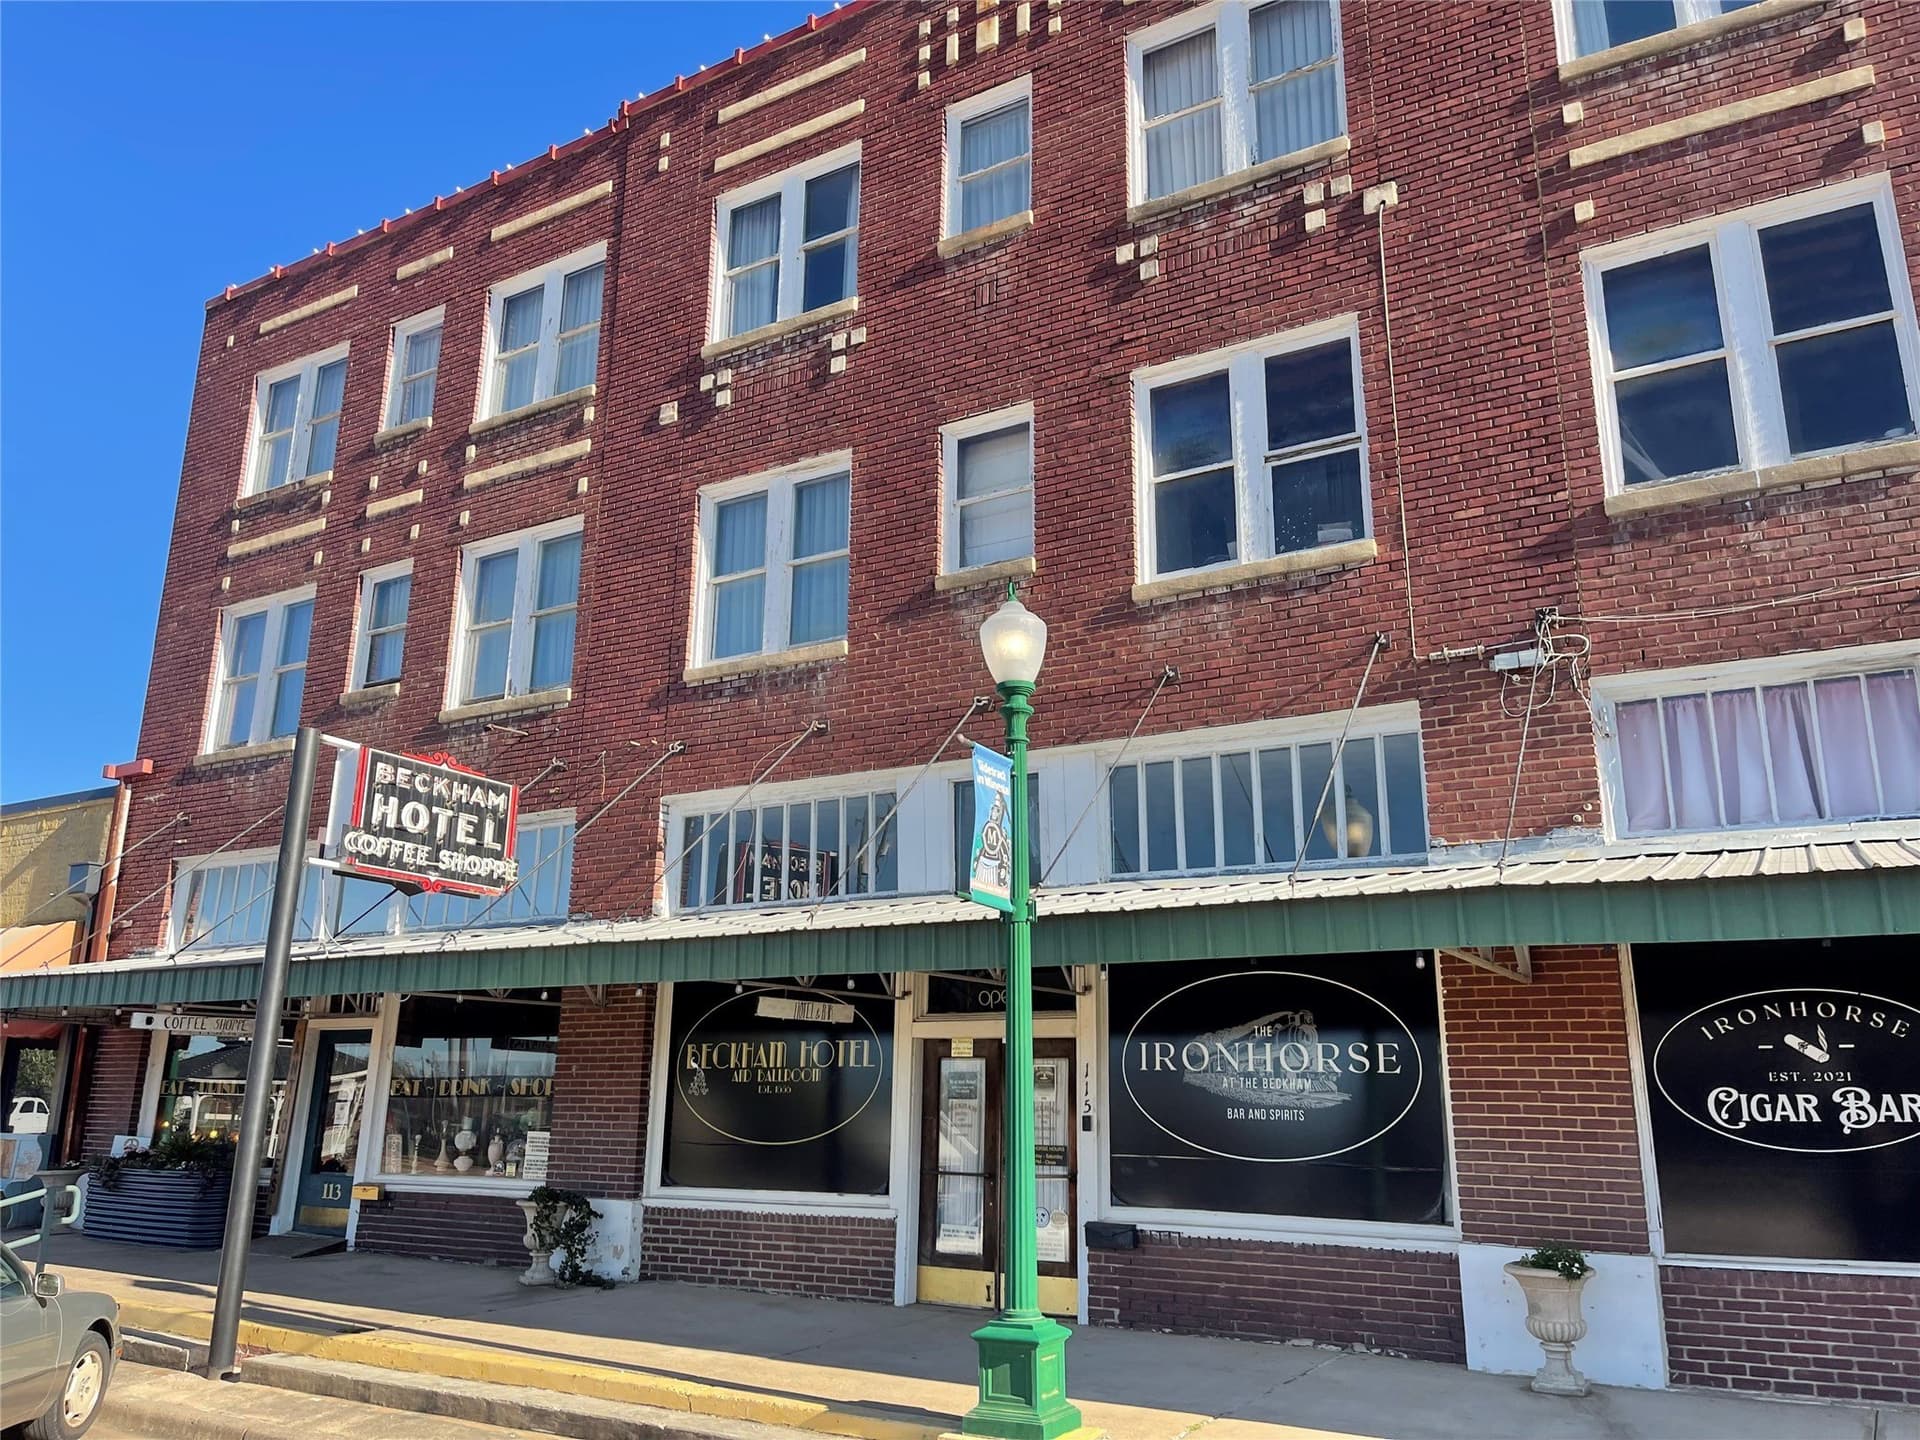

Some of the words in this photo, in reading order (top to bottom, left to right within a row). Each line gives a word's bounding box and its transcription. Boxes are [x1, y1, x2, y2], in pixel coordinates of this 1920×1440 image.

[376, 761, 507, 812] BECKHAM
[372, 793, 501, 850] HOTEL
[987, 829, 997, 846] M
[344, 830, 431, 867] COFFEE
[439, 849, 519, 882] SHOPPE
[164, 1016, 207, 1030] COFFEE
[215, 1018, 248, 1031] SHOPPE
[1701, 1001, 1910, 1041] IRONHORSE
[1254, 1025, 1273, 1037] THE
[686, 1040, 787, 1070] BECKHAM
[800, 1039, 876, 1068] HOTEL
[1139, 1042, 1402, 1075] IRONHORSE
[731, 1069, 752, 1083] AND
[758, 1068, 822, 1083] BALLROOM
[1222, 1077, 1234, 1089] AT
[1240, 1077, 1258, 1089] THE
[1262, 1077, 1312, 1090] BECKHAM
[1768, 1071, 1806, 1082] EST.
[1812, 1071, 1852, 1082] 2021
[390, 1079, 422, 1097] EAT
[439, 1078, 492, 1096] DRINK
[1227, 1108, 1245, 1120] BAR
[1248, 1108, 1267, 1120] AND
[1269, 1109, 1305, 1121] SPIRITS
[1707, 1086, 1822, 1130] CIGAR
[1832, 1086, 1920, 1135] BAR
[321, 1183, 342, 1200] 113
